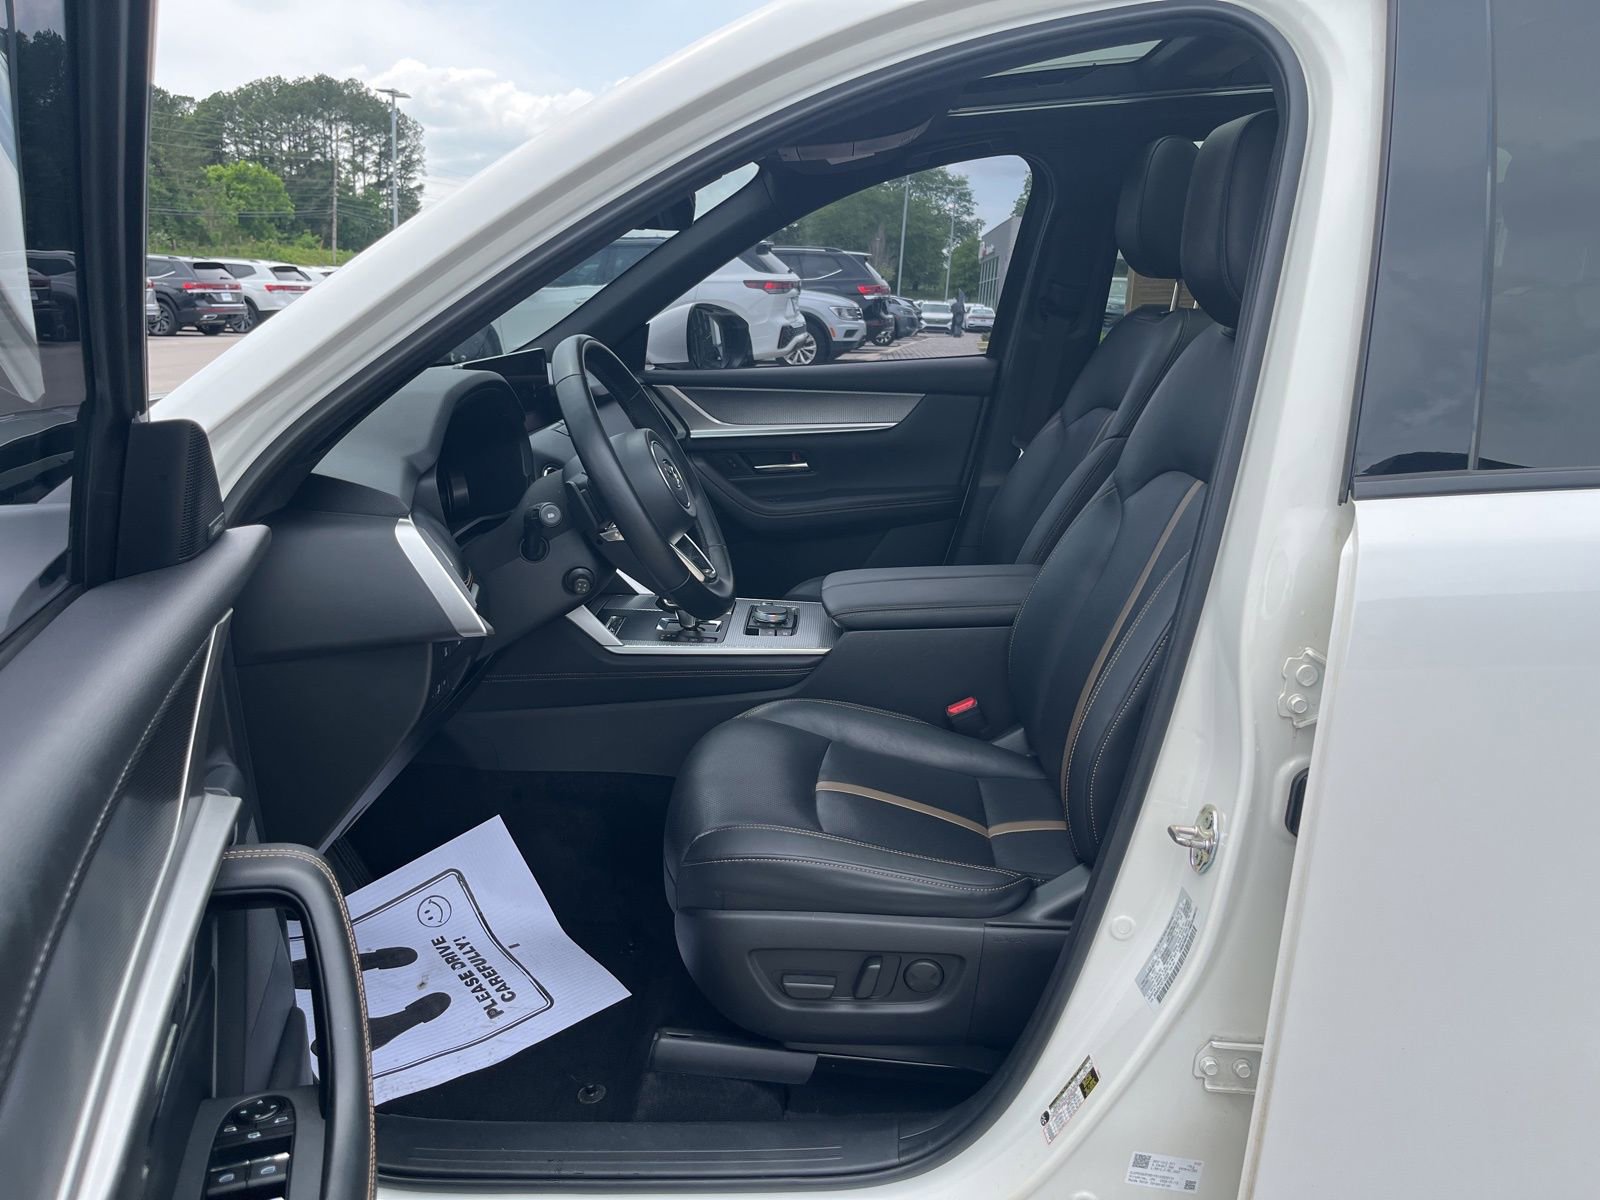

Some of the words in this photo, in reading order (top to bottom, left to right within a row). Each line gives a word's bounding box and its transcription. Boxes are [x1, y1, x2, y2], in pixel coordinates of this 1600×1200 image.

[431, 935, 467, 971] DRIVE
[453, 936, 516, 1002] CAREFULLY!
[458, 970, 504, 1019] PLEASE
